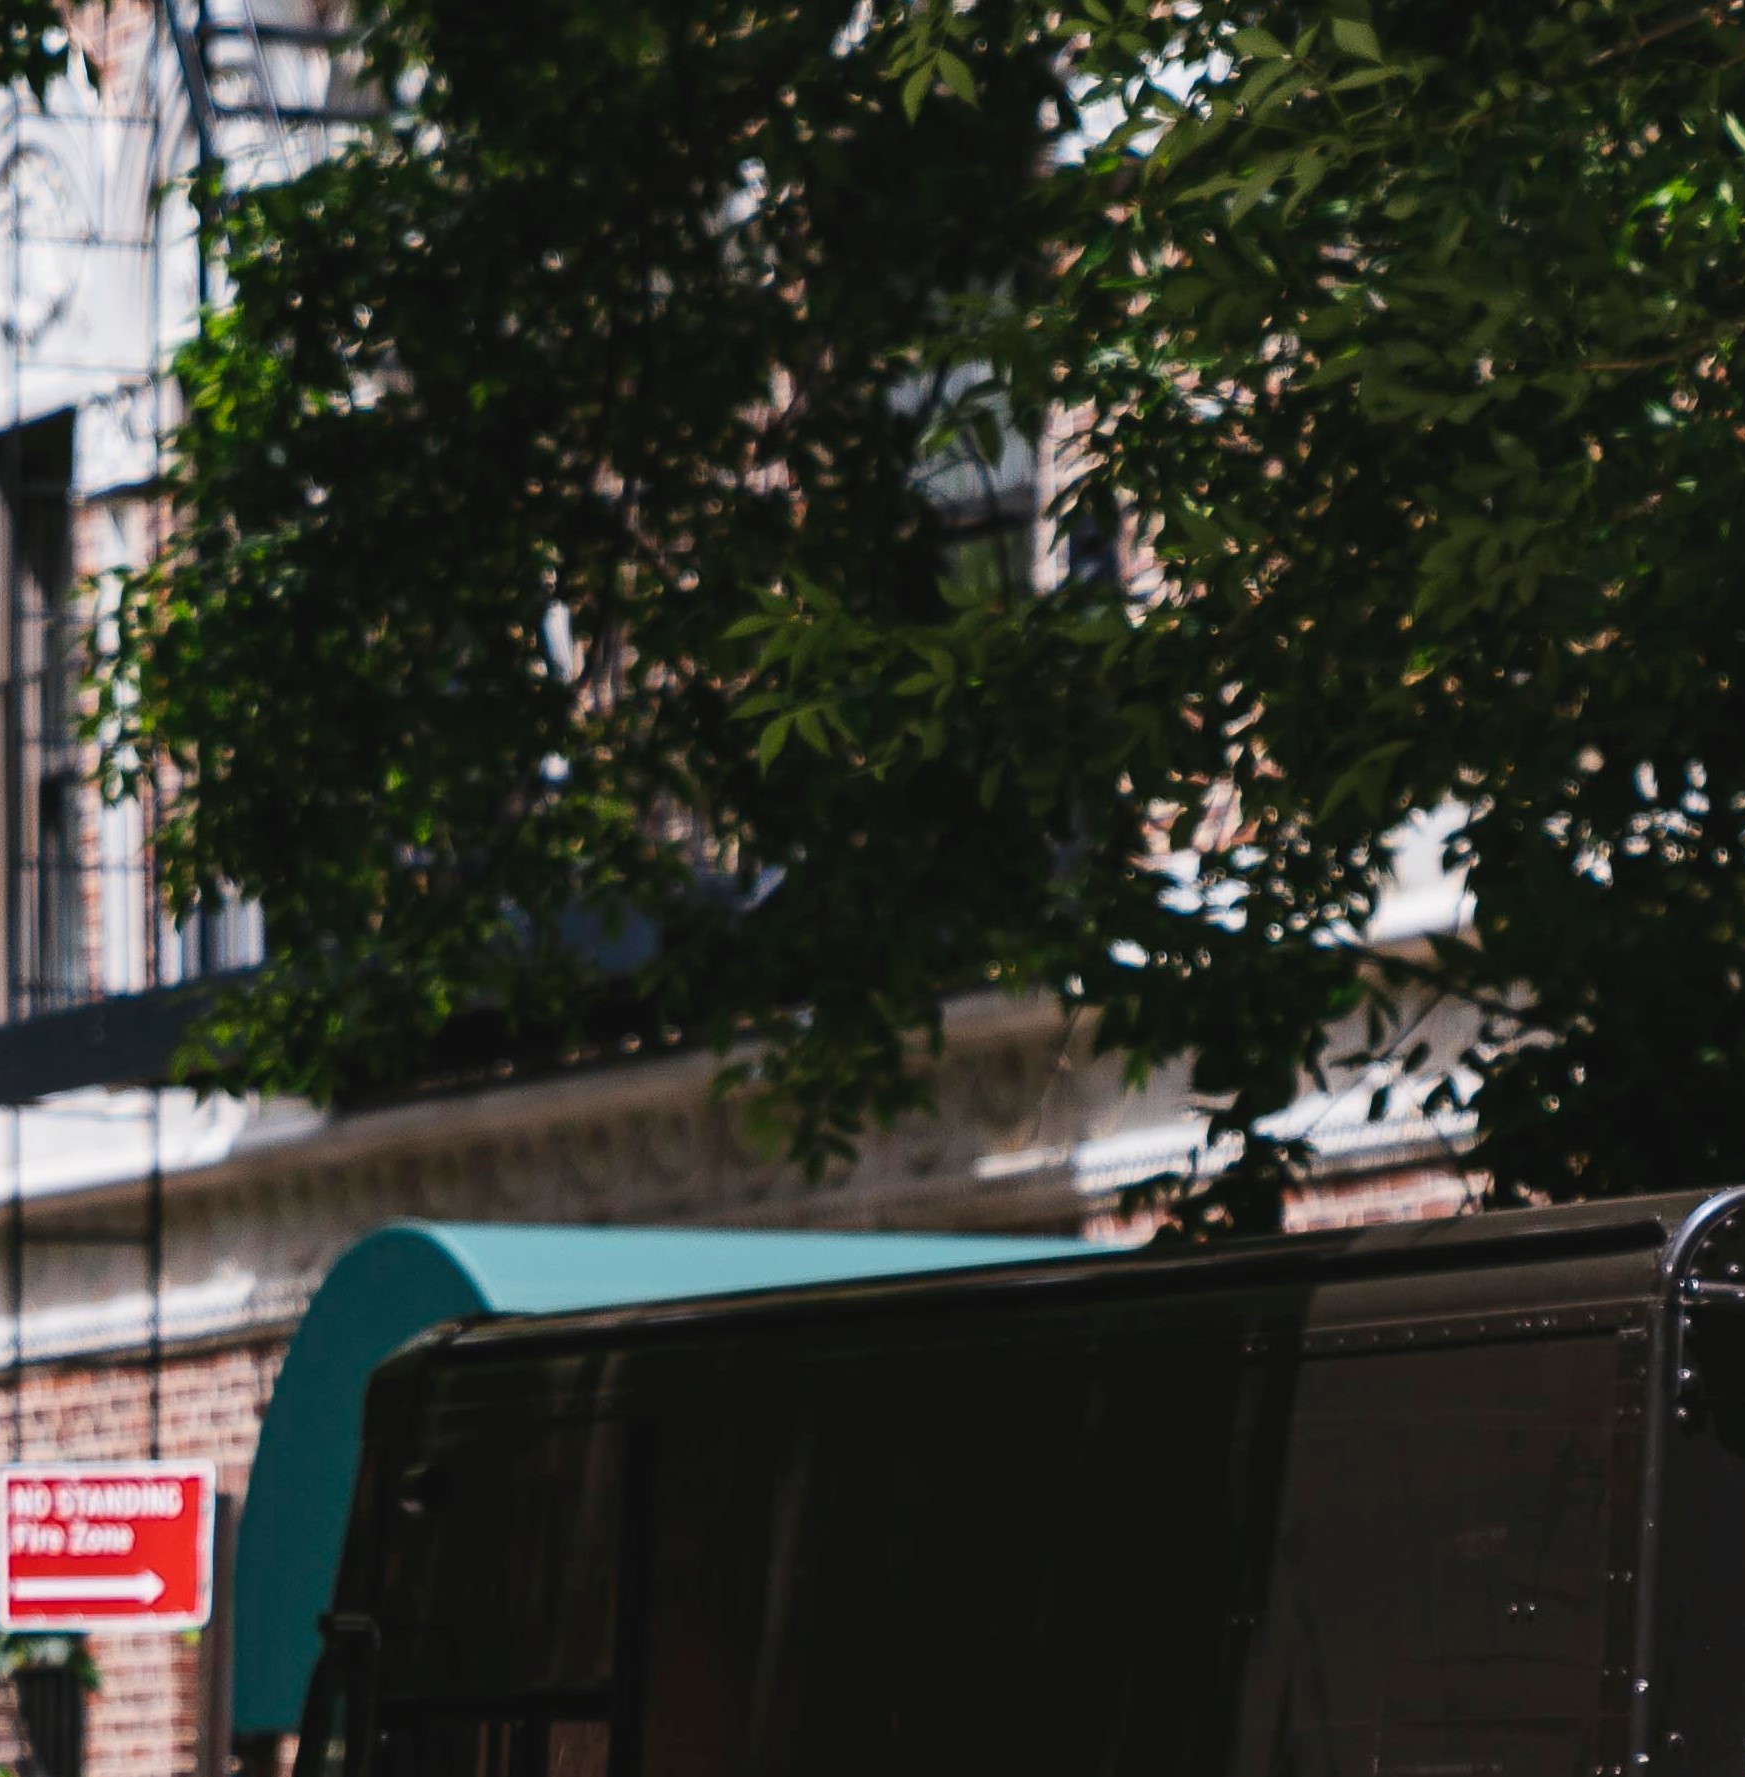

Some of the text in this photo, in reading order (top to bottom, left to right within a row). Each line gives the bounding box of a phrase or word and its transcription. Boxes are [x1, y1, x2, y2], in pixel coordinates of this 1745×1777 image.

[11, 1480, 184, 1519] NO STANDING
[11, 1519, 136, 1556] Fire Zone
